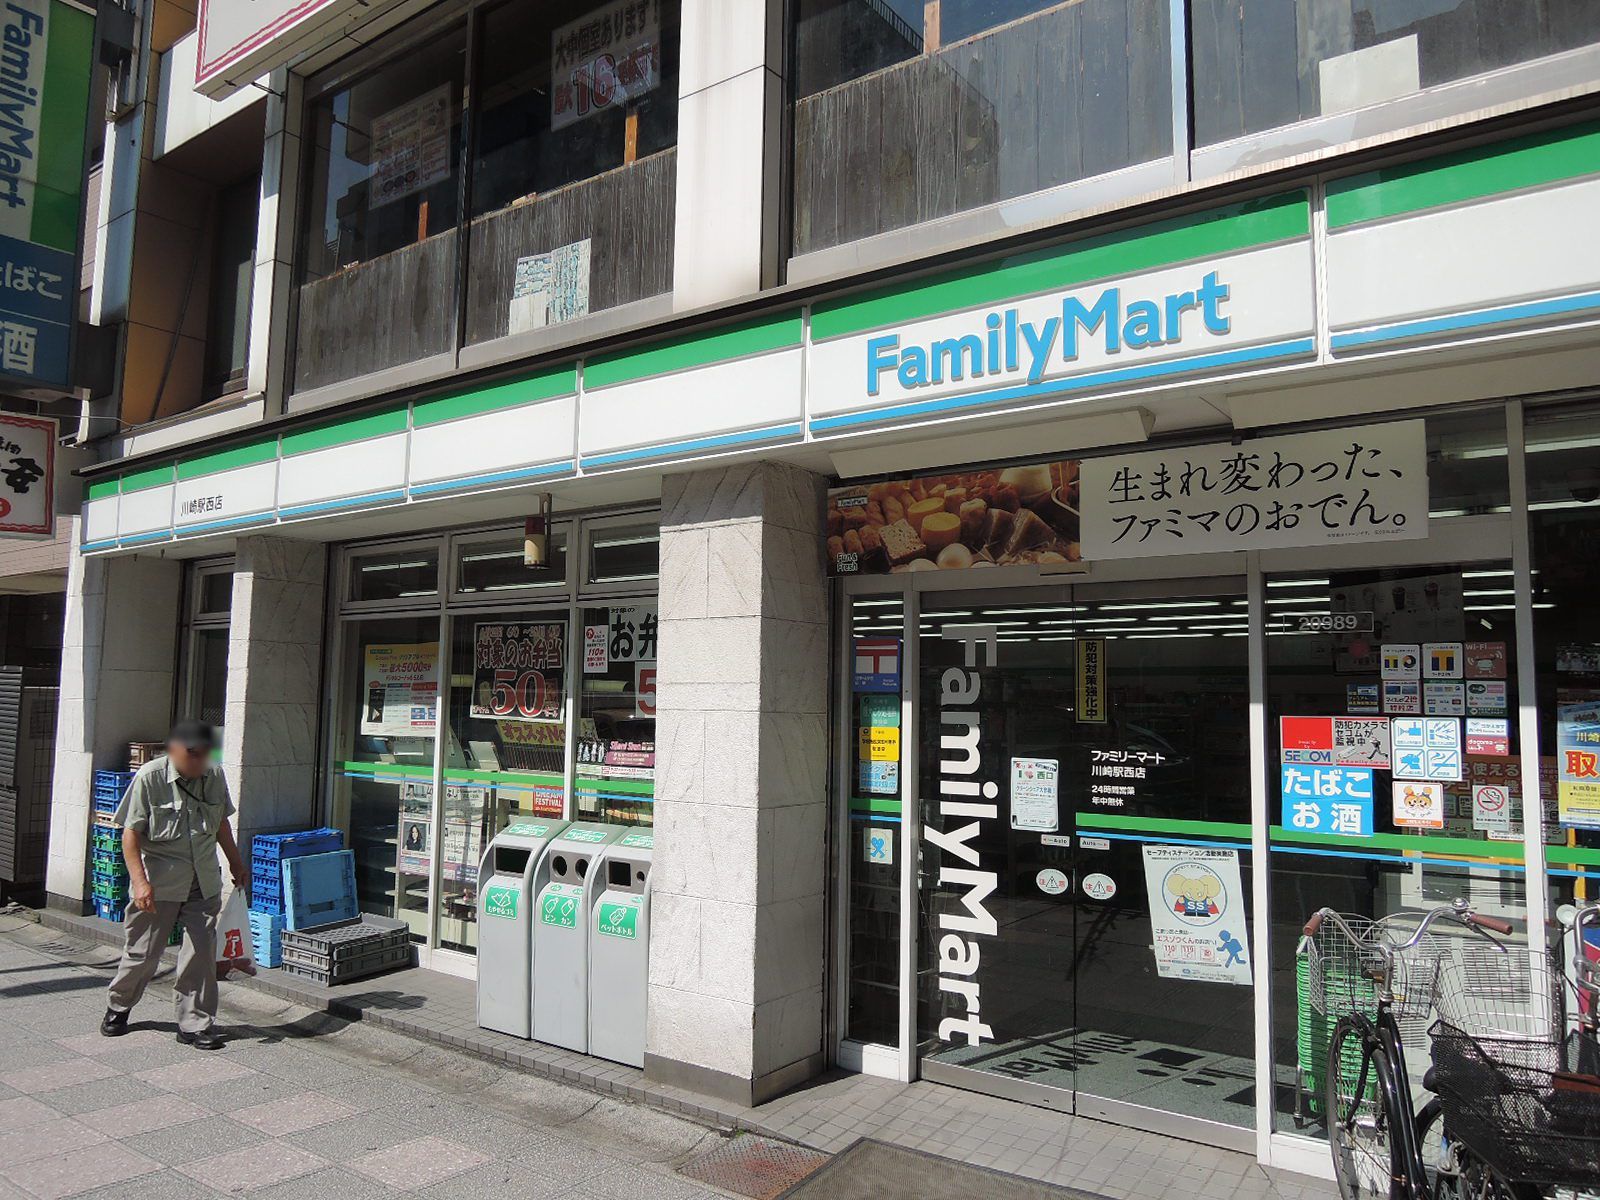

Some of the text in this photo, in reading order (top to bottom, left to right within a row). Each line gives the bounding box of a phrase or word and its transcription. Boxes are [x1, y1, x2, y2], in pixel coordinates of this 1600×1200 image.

[0, 3, 43, 209] FamilyMart
[0, 262, 63, 301] ばこ
[866, 270, 1230, 397] FamilyMart
[1109, 443, 1402, 503] 生まれ変わった、
[181, 495, 223, 516] 川崎駅西店
[1111, 488, 1406, 544] ファミマのおでん。
[836, 562, 858, 572] Fresh
[1298, 615, 1358, 631] 20989
[476, 638, 563, 669] 対象のお弁当
[1085, 642, 1098, 719] 防犯対策強化中
[490, 669, 546, 718] 50
[1335, 721, 1388, 730] 防犯カメラで
[1336, 729, 1373, 738] セコムが
[1335, 737, 1366, 746] 監視中
[1091, 750, 1166, 765] ファミリーマート
[1285, 751, 1331, 762] SECOM
[1565, 751, 1598, 777] 取
[1091, 765, 1147, 779] 川崎駅西店
[1091, 784, 1136, 796] 24時間営業
[1284, 768, 1371, 798] たばこ
[535, 798, 563, 807] FESTIVAL
[1091, 796, 1124, 807] 年中無休
[1293, 802, 1362, 833] お酒
[923, 625, 998, 1048] FamilyMart
[487, 905, 514, 917] もやせるゴミ
[1188, 901, 1205, 911] SS
[545, 914, 572, 925] ビン カン
[601, 924, 633, 936] ペットボトル
[1183, 945, 1194, 953] 119
